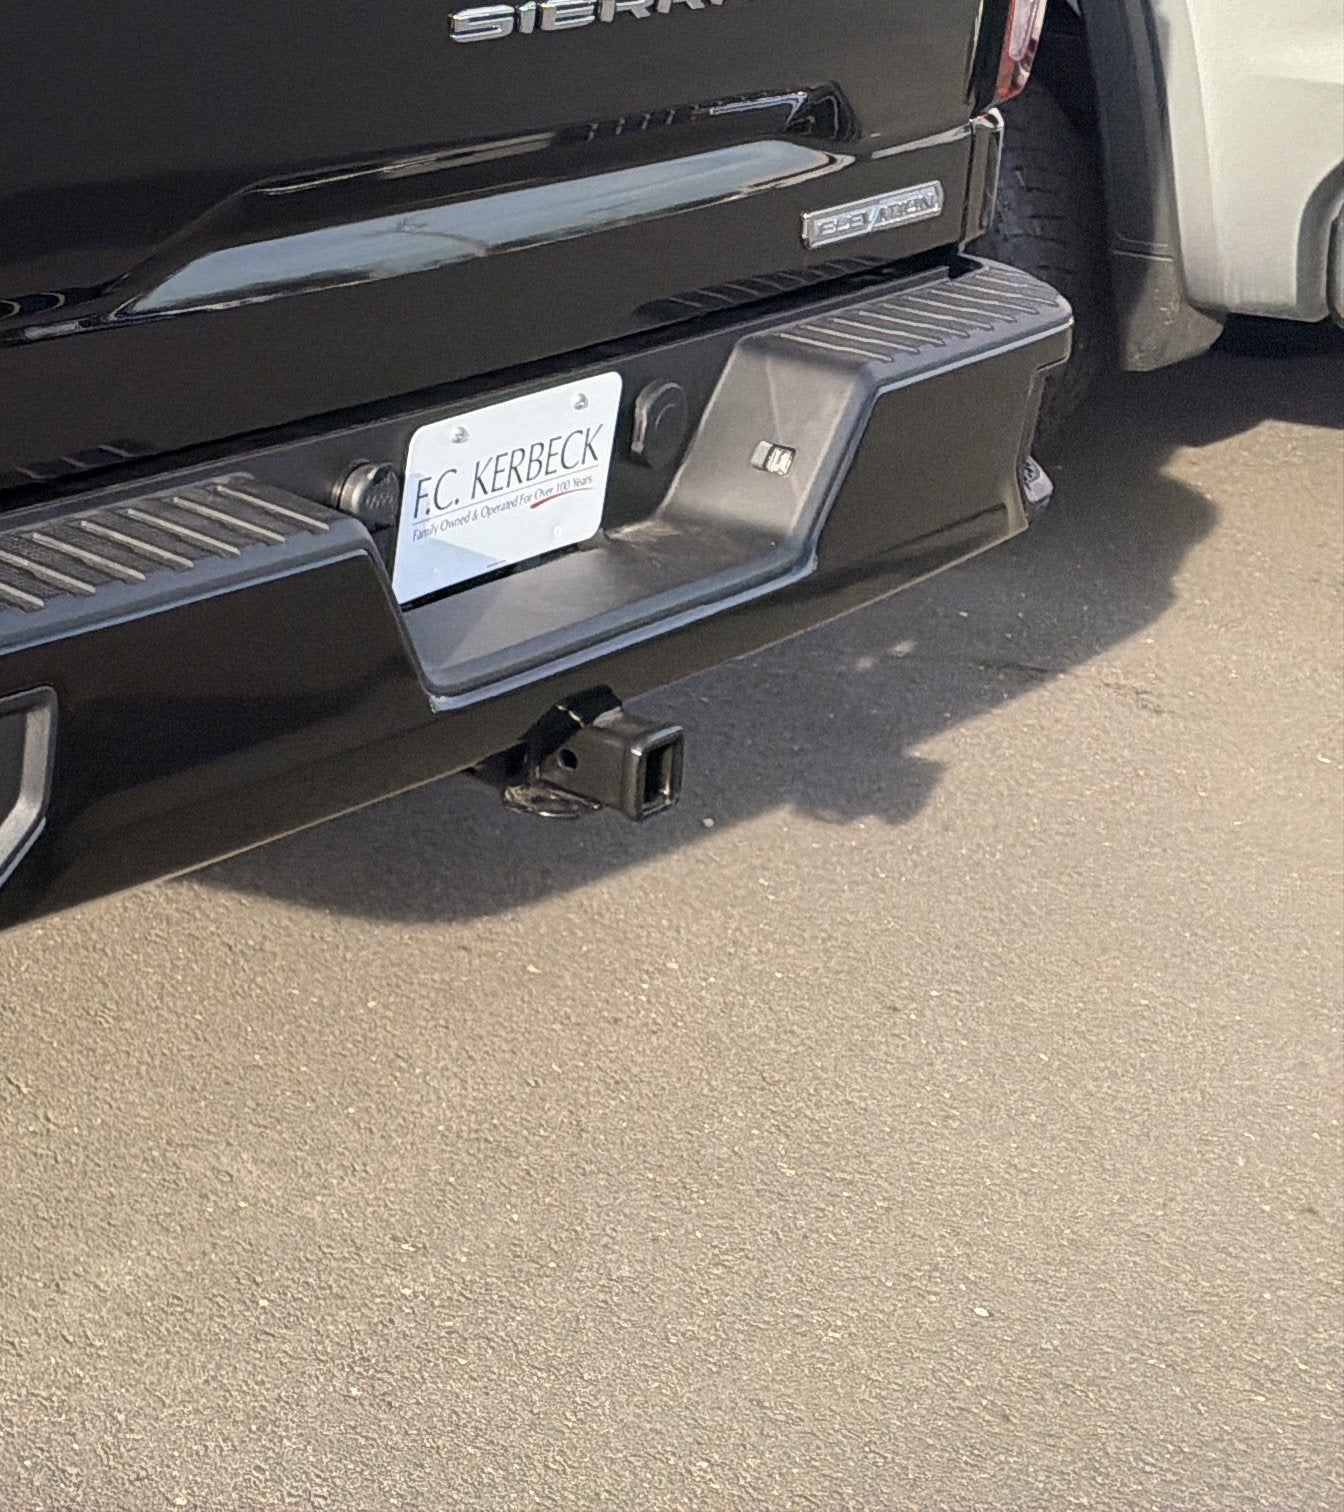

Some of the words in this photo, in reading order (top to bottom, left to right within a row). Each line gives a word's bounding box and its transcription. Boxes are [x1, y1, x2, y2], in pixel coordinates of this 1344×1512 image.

[413, 468, 460, 519] F.C.
[471, 423, 604, 500] KERBECK
[413, 521, 440, 542] Family
[440, 510, 472, 531] Owned
[480, 494, 519, 519] Operated
[519, 493, 533, 504] For
[534, 487, 555, 500] Over
[572, 475, 593, 488] Years
